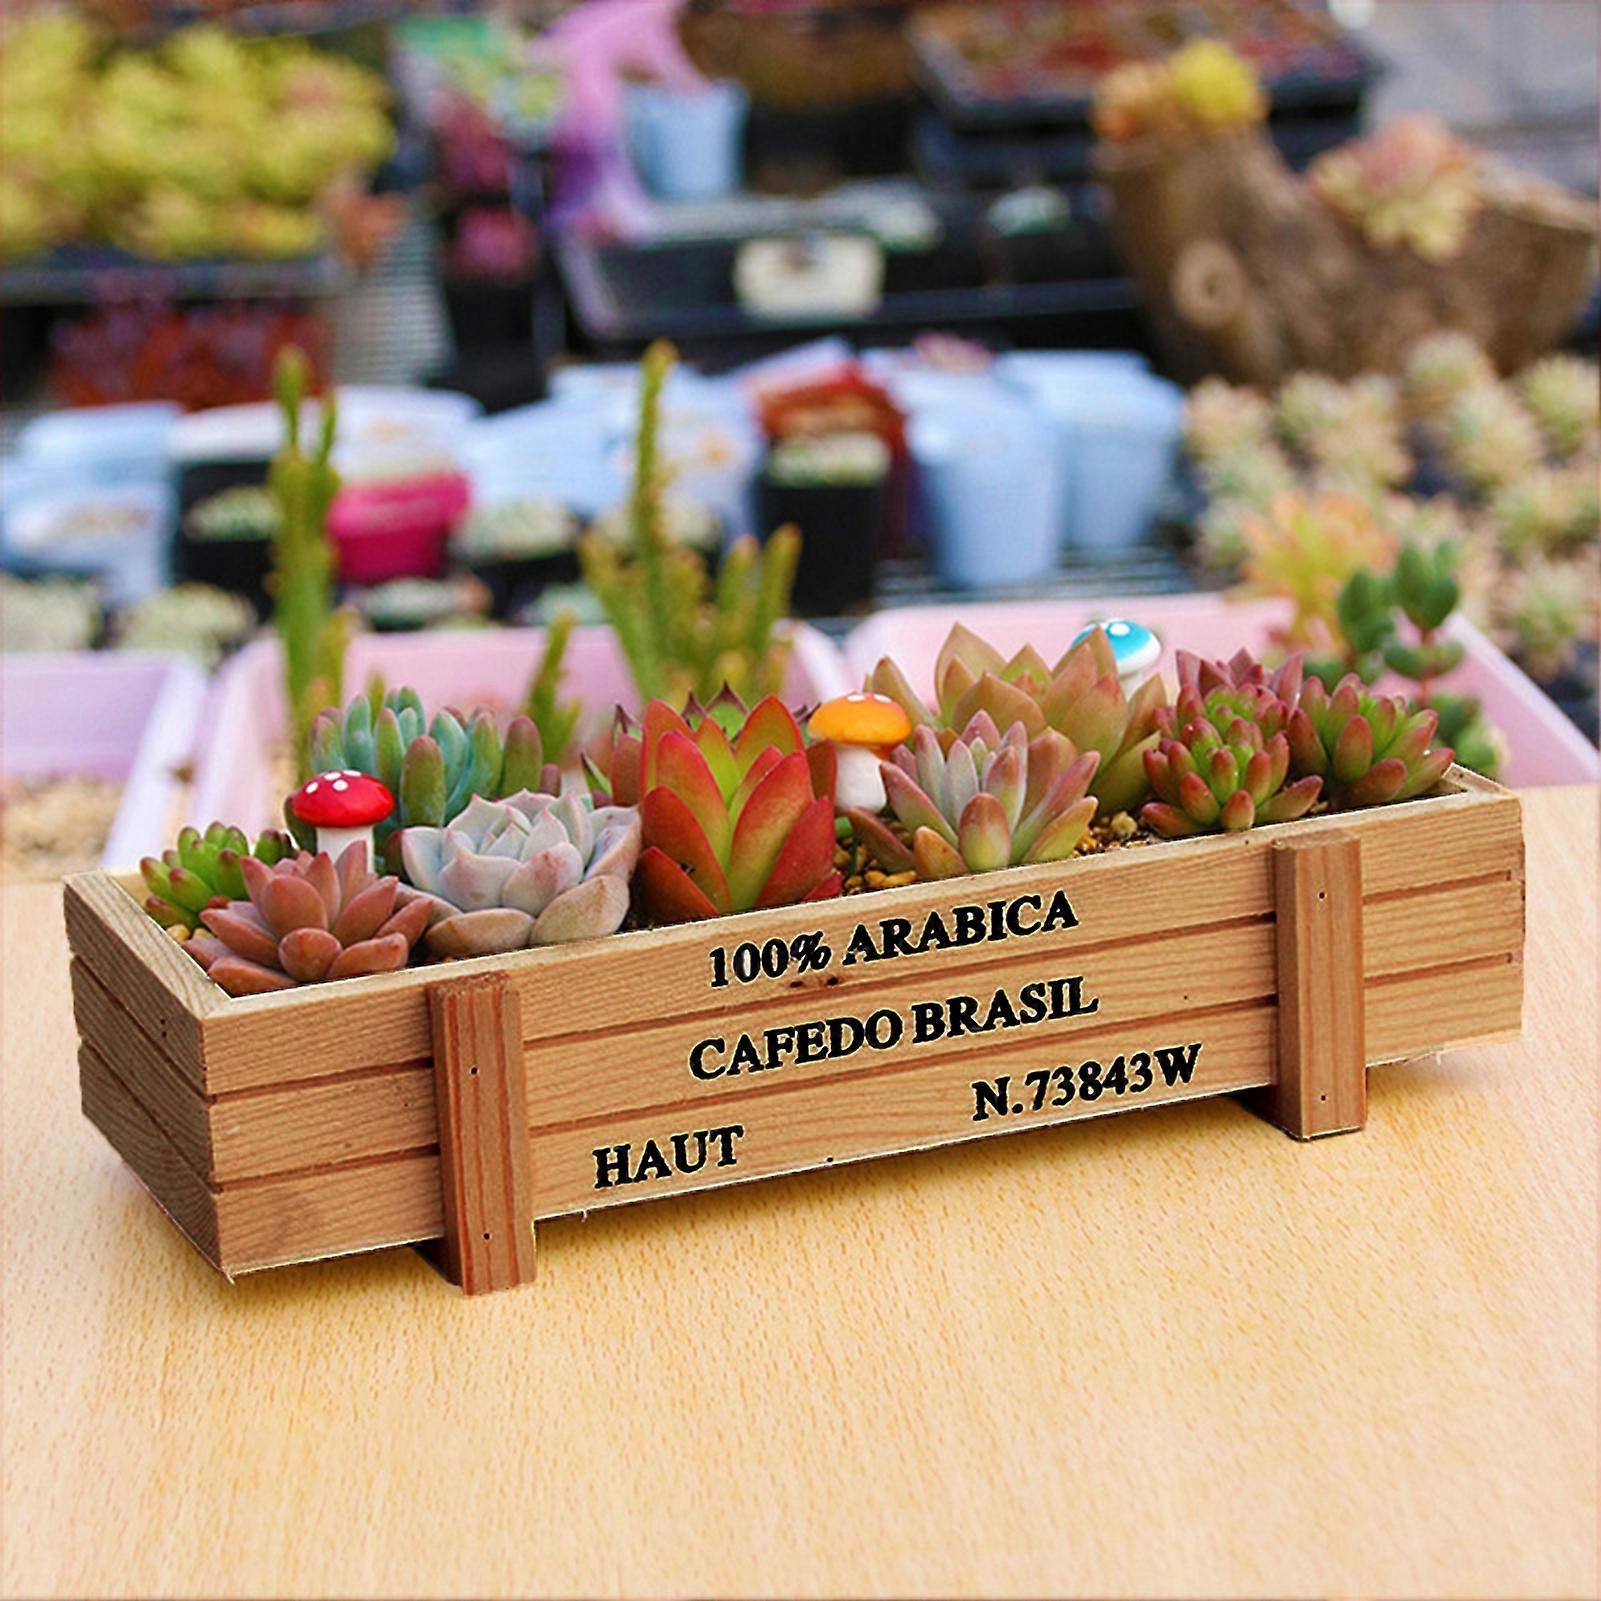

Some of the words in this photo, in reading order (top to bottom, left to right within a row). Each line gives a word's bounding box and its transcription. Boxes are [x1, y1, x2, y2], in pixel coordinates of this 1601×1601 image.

[709, 930, 832, 988] 100%
[842, 890, 1079, 966] ARABICA
[911, 976, 1099, 1044] BRASIL
[971, 1043, 1202, 1121] N.73843W
[592, 1125, 744, 1189] HAUT
